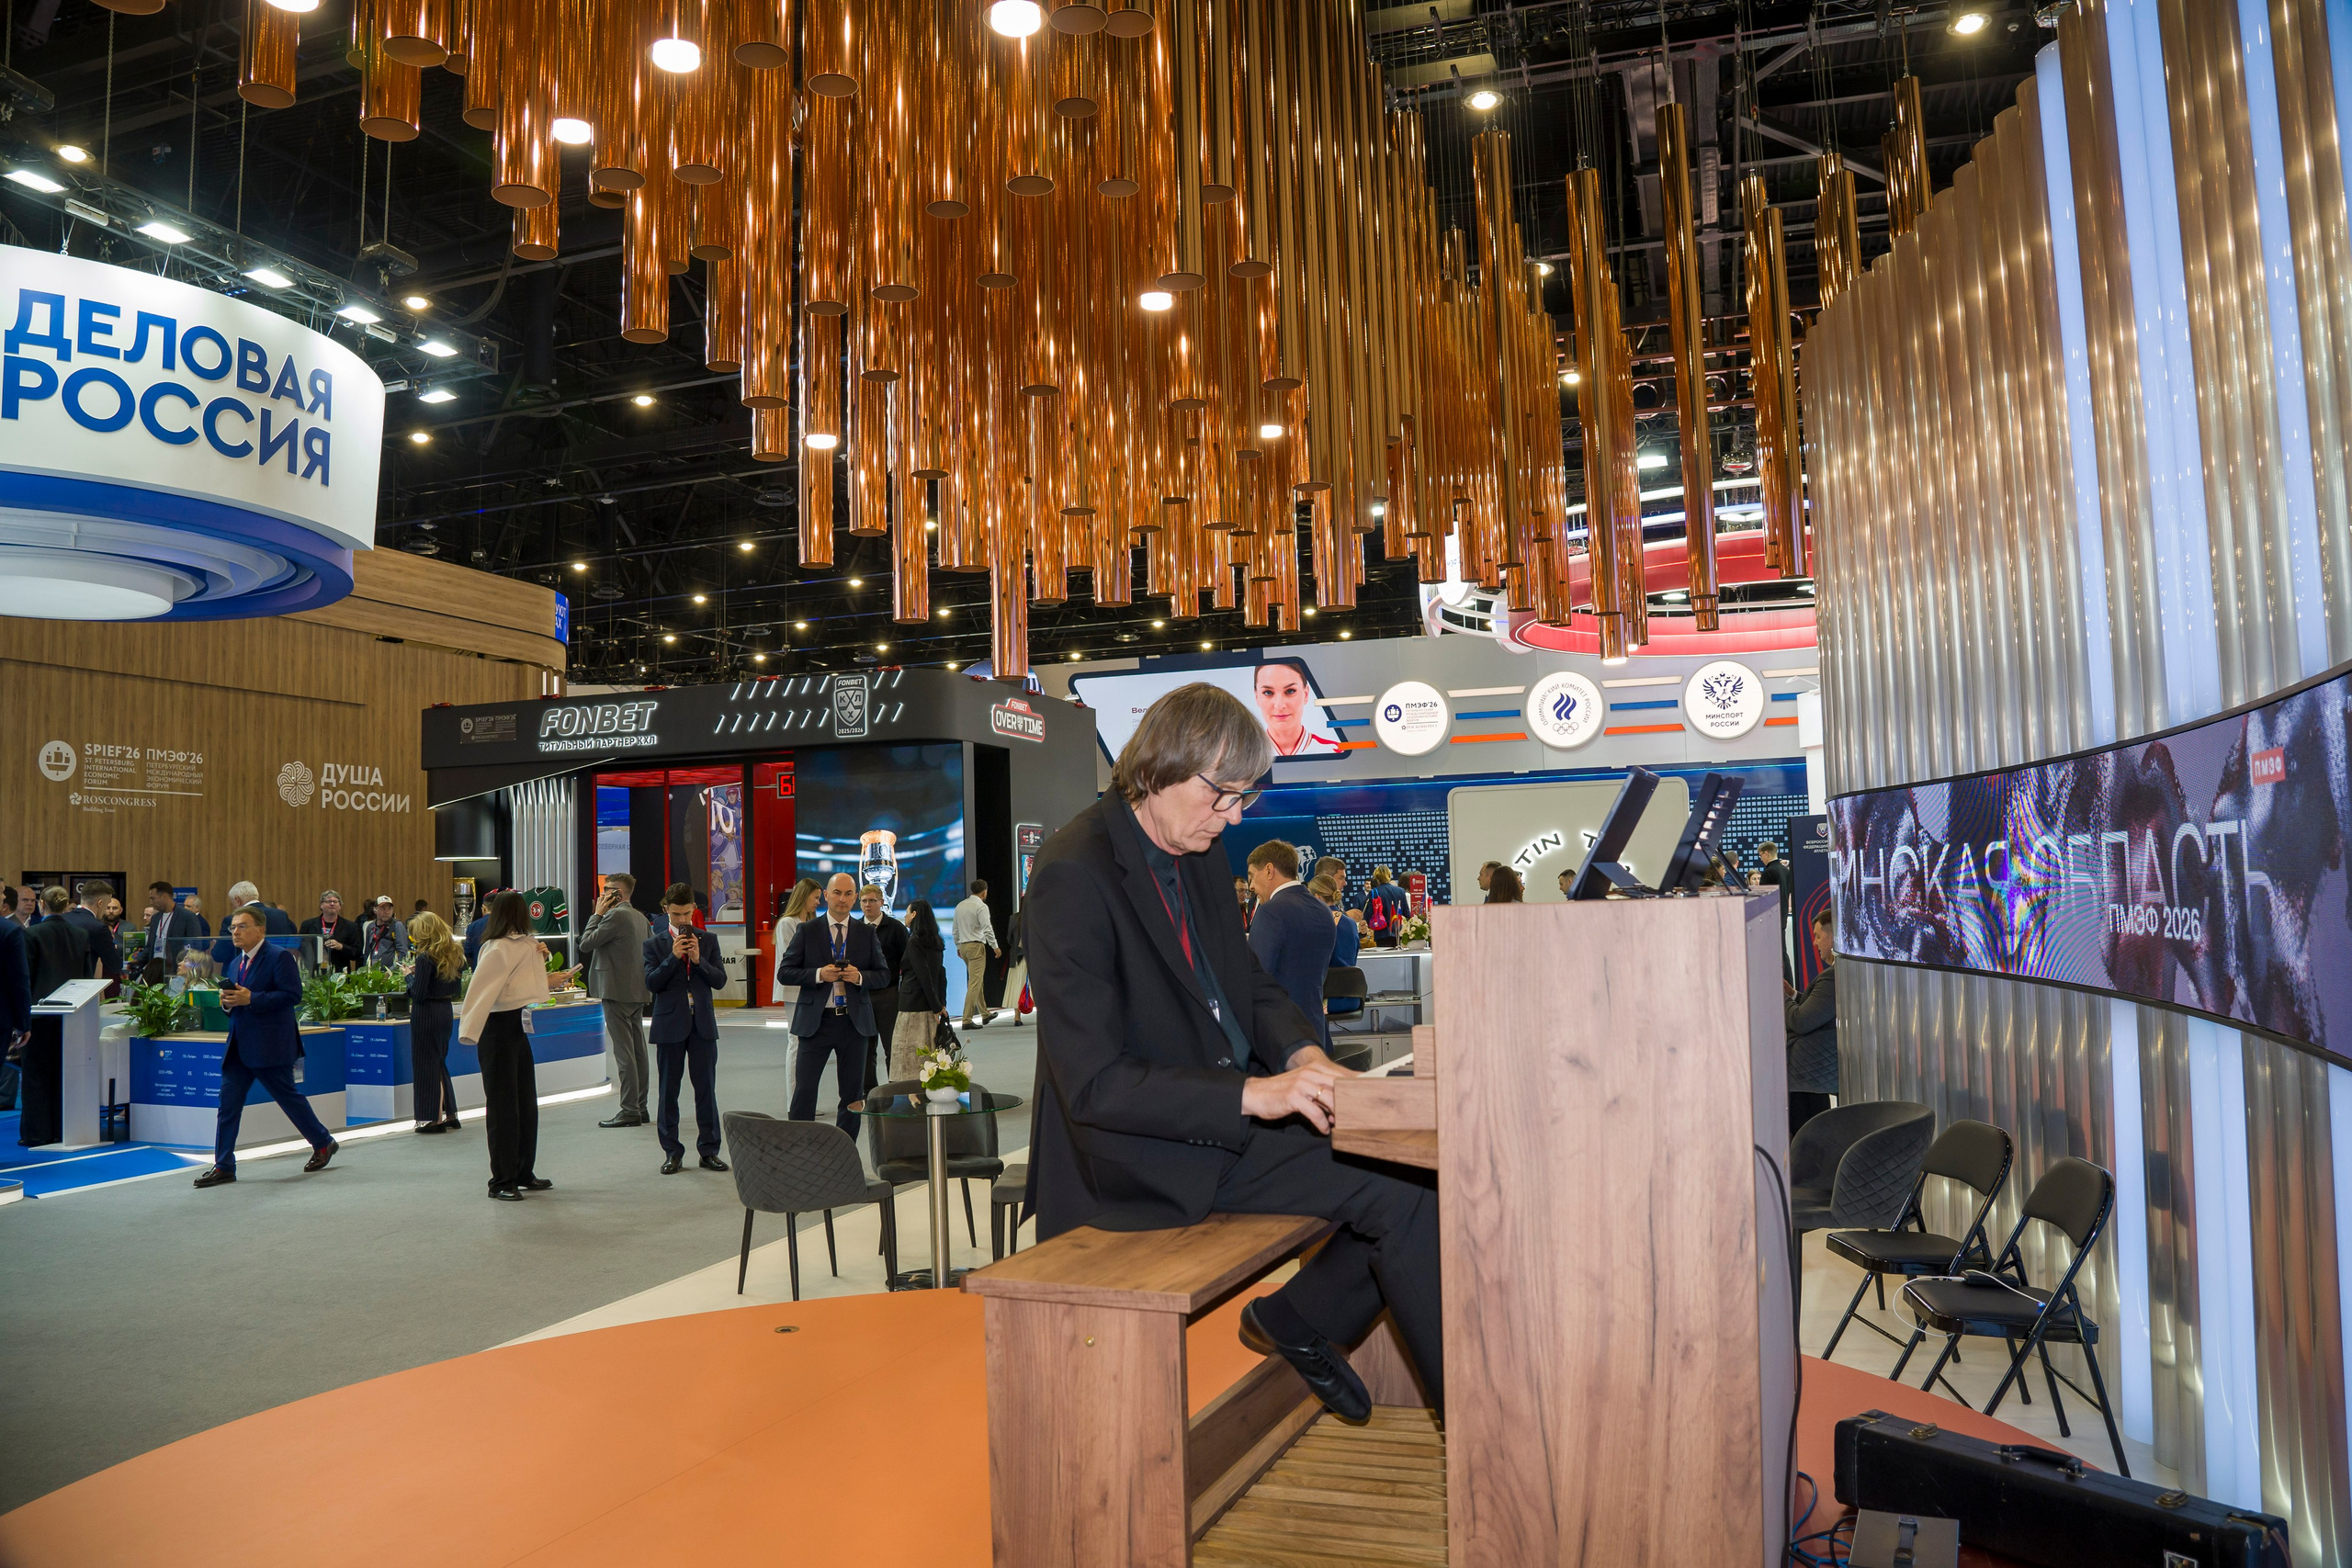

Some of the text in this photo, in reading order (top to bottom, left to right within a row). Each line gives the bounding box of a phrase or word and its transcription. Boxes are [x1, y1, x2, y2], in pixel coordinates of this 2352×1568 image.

[4, 288, 333, 422] ДЕЛОВАЯ
[1, 355, 332, 487] РОССИЯ
[837, 678, 863, 686] FONBET
[1406, 701, 1438, 709] ПМЭФ'26
[1538, 682, 1592, 727] ОЛИМПИЙСКИЙ КОМИТЕТ РОССИИ
[538, 701, 658, 739] FONBET
[995, 710, 1043, 737] OVER TIME
[1705, 712, 1744, 720] МИНСПОРТ
[85, 742, 141, 760] SPIEF'26
[538, 735, 657, 751] ТИТУЛЬНЫЙ ПАРТНЕР КХЛ
[95, 758, 135, 767] PETERSBURG
[146, 748, 204, 764] ПМЭФ'26
[85, 764, 137, 774] INTERNATIONAL
[146, 761, 197, 772] ПЕТЕРБУРГСКИЙ
[146, 769, 204, 779] МЕЖДУНАРОДНЫЙ
[321, 762, 384, 788] ДУША
[2254, 755, 2282, 778] ПМЭФ
[85, 771, 120, 780] ECONOMIC
[146, 775, 202, 785] ЭКОНОМИЧЕСКИЙ
[780, 775, 795, 795] 6
[83, 795, 157, 807] ROSCONGRESS
[322, 789, 410, 814] РОССИИ
[1514, 832, 1562, 877] TIN
[2109, 904, 2201, 942] ПМЭФ 2026
